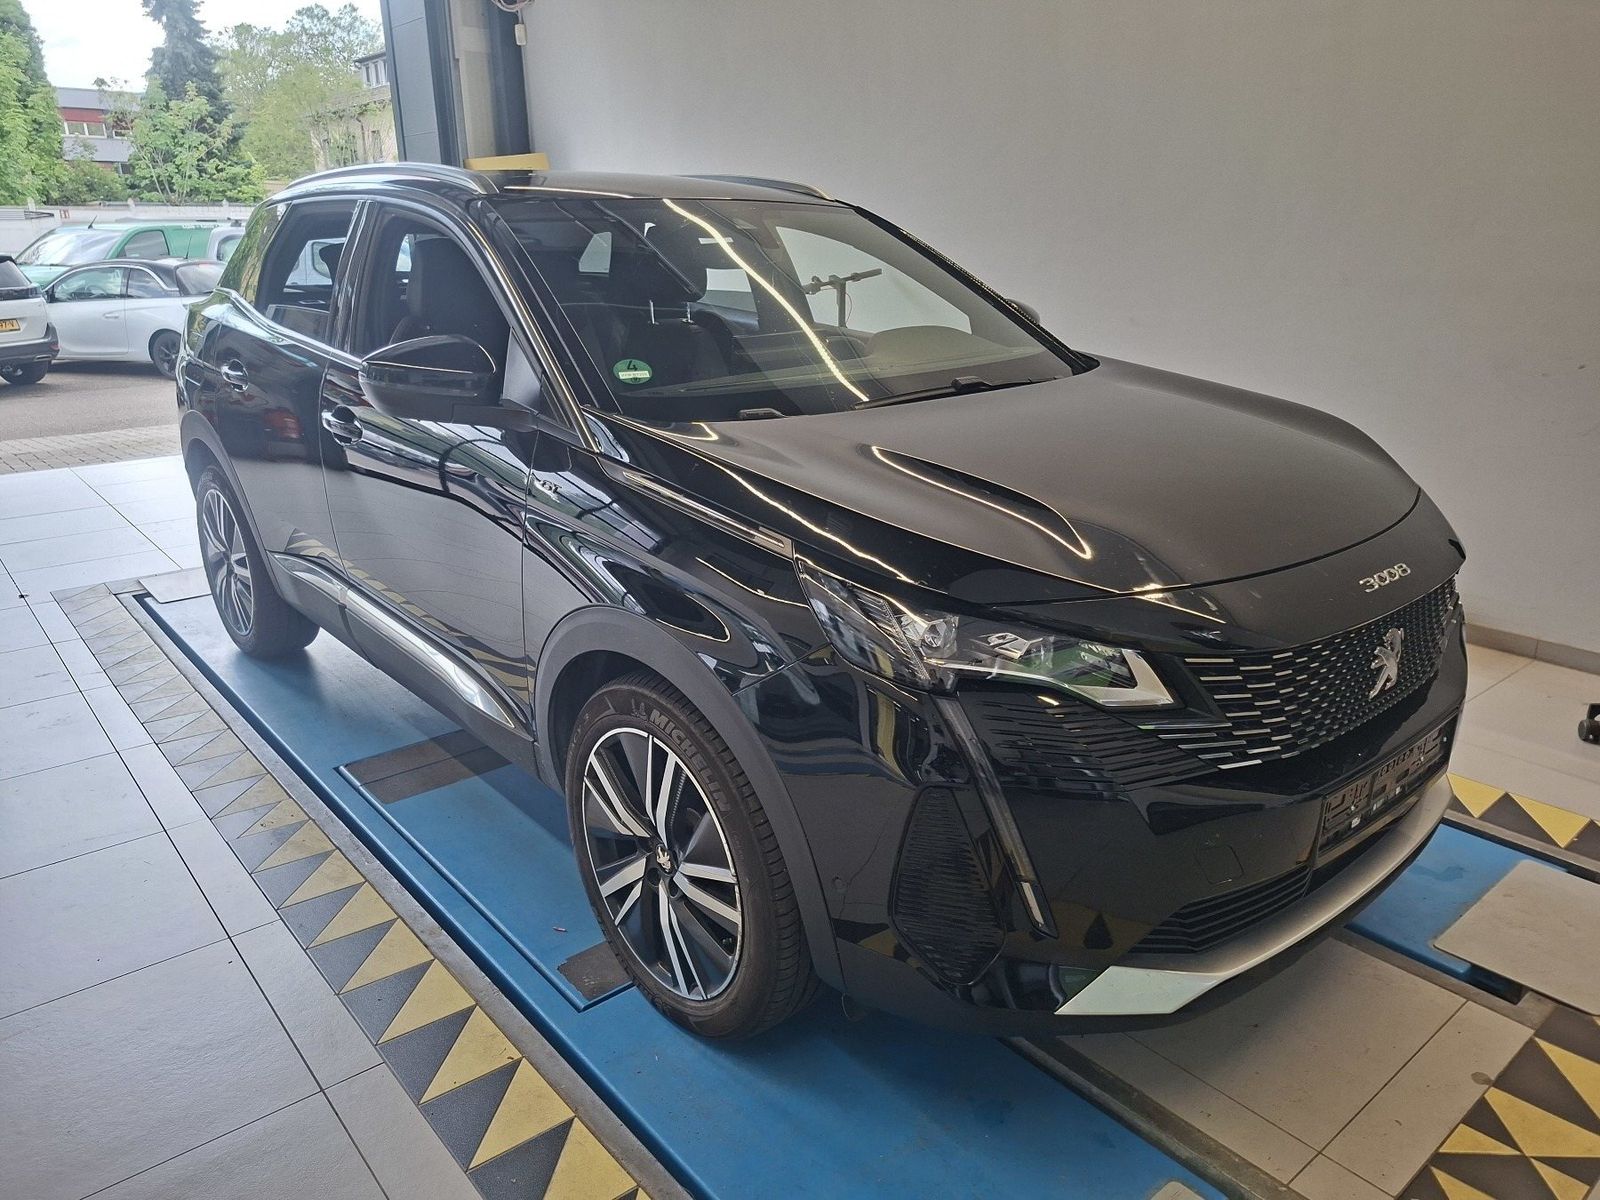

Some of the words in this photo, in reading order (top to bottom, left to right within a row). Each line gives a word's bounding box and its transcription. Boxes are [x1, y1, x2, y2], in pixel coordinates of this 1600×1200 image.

[627, 360, 638, 371] 4
[541, 479, 563, 494] GT
[1358, 562, 1412, 593] 3008
[649, 708, 732, 813] MICHELIN
